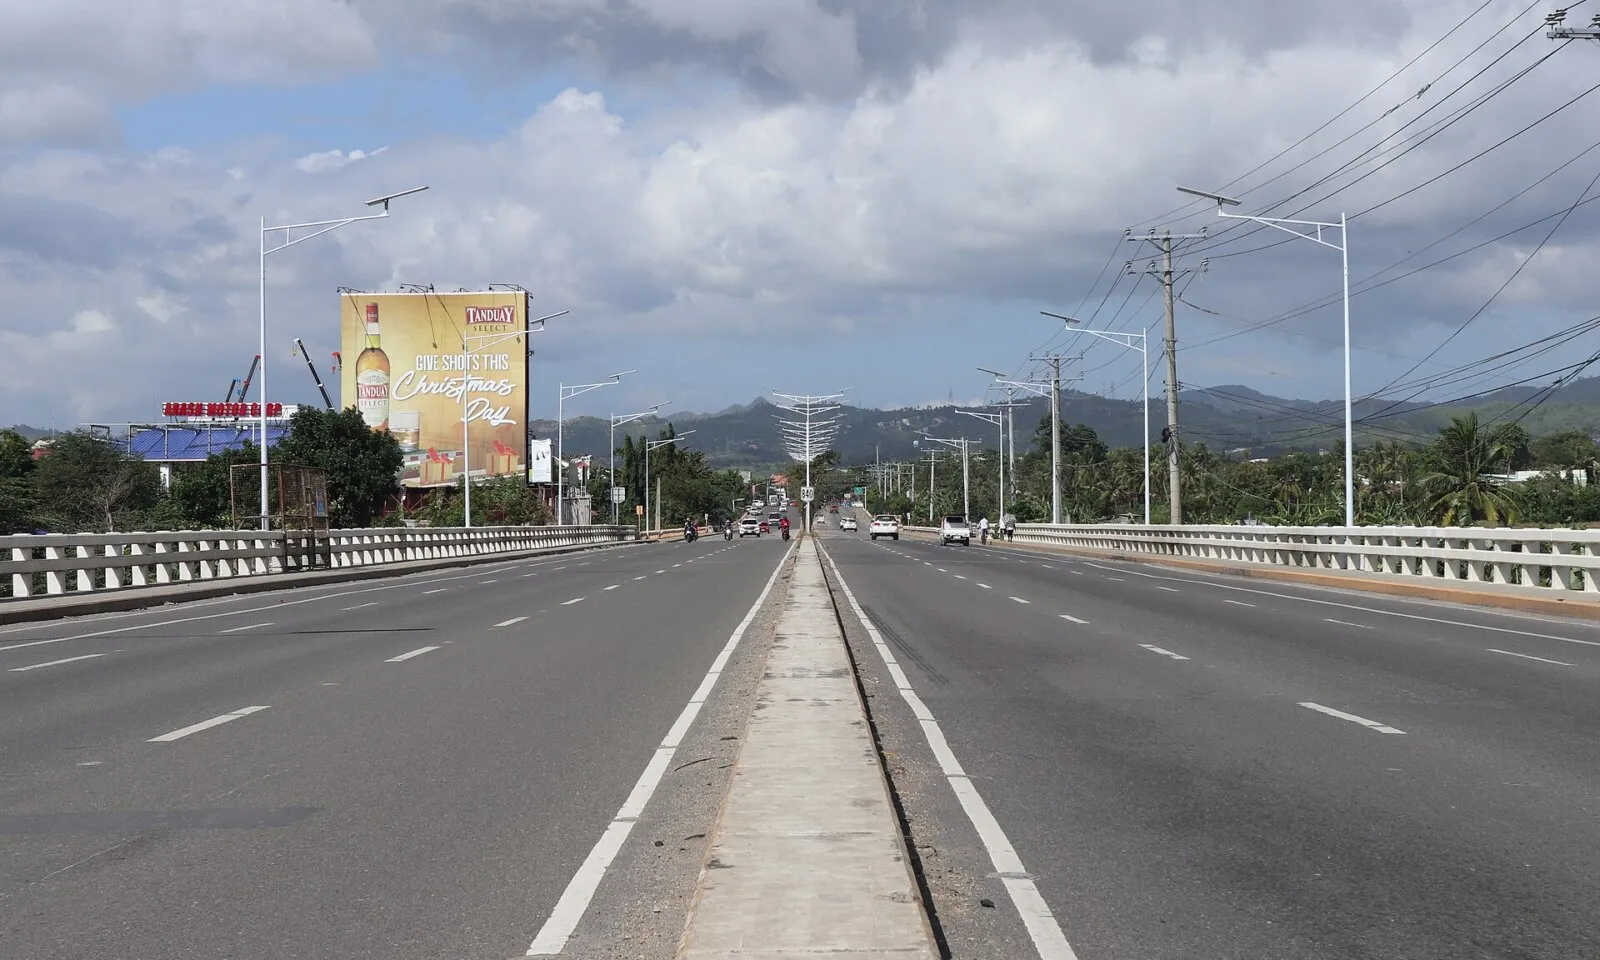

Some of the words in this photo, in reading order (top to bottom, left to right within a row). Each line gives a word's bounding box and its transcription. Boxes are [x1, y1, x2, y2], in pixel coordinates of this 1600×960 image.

[467, 307, 513, 323] TANDUAY
[416, 354, 439, 371] GIVE
[442, 354, 480, 371] SHOTS
[483, 353, 509, 370] THIS
[358, 385, 388, 397] TANDUAY
[392, 370, 516, 404] Christmas
[460, 397, 517, 426] Day
[802, 489, 813, 498] 840
